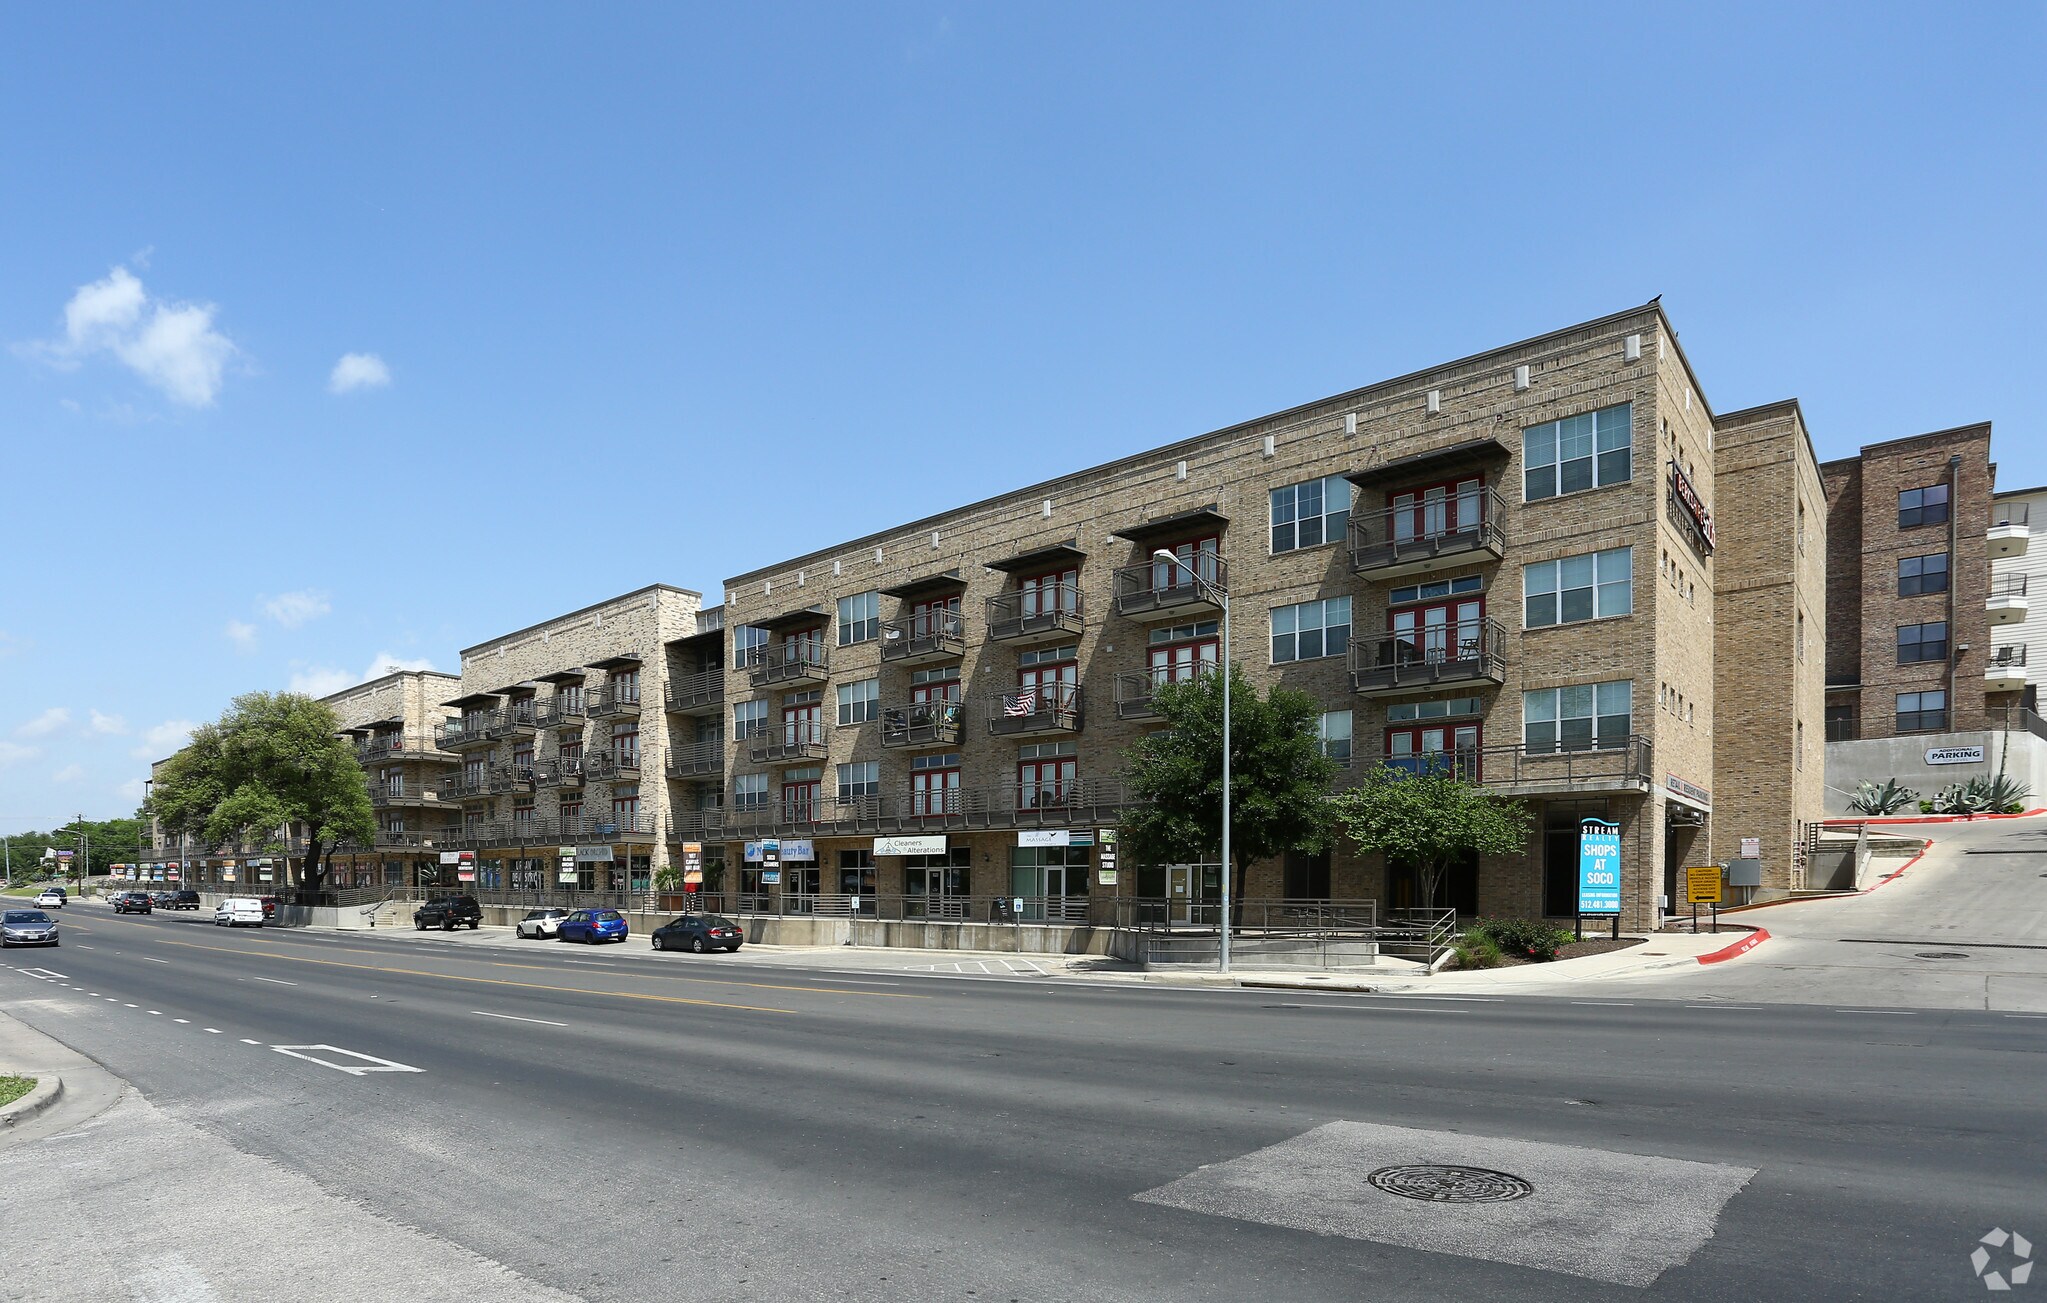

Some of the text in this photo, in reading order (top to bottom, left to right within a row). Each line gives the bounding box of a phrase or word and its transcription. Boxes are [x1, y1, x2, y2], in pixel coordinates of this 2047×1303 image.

[1932, 751, 1980, 759] PARKING
[1582, 825, 1619, 835] STREAM
[797, 846, 809, 855] Bar
[1584, 844, 1617, 857] SHOPS
[1594, 858, 1607, 870] AT
[1587, 872, 1614, 885] SOCO
